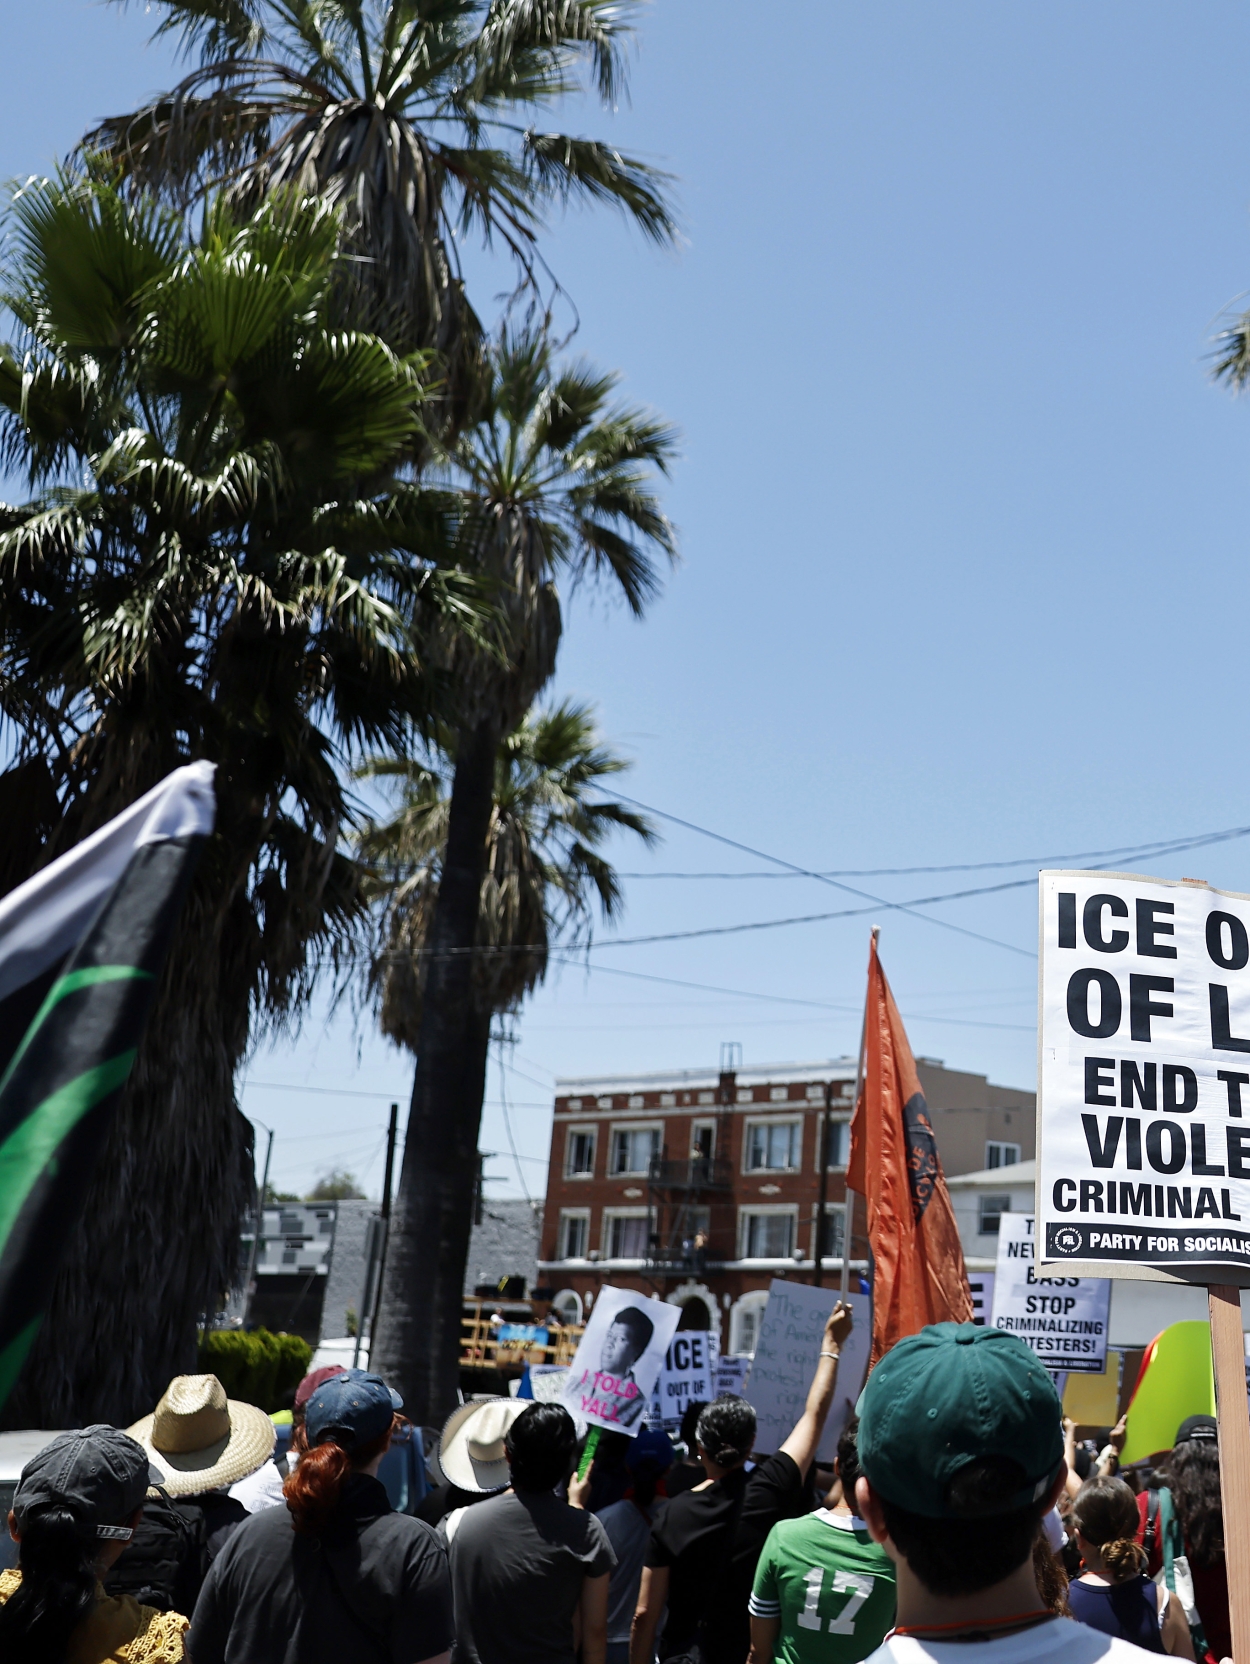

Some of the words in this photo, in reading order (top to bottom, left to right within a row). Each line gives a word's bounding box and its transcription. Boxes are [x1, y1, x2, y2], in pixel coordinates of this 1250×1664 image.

[1058, 892, 1178, 960] ICE
[1066, 967, 1175, 1043] OF
[1084, 1056, 1198, 1114] END
[1052, 1177, 1241, 1222] CRIMINAL
[1089, 1232, 1143, 1251] PARTY
[1146, 1235, 1179, 1253] FOR
[1026, 1295, 1076, 1315] STOP
[997, 1316, 1104, 1335] CRIMINALIZING
[665, 1338, 703, 1371] ICE
[1018, 1335, 1096, 1353] OTESTERS!
[581, 1369, 588, 1384] I
[593, 1372, 638, 1399] TOLD
[667, 1381, 690, 1397] OUT
[693, 1379, 705, 1394] OF
[581, 1395, 621, 1423] YALL
[797, 1566, 875, 1635] 17
